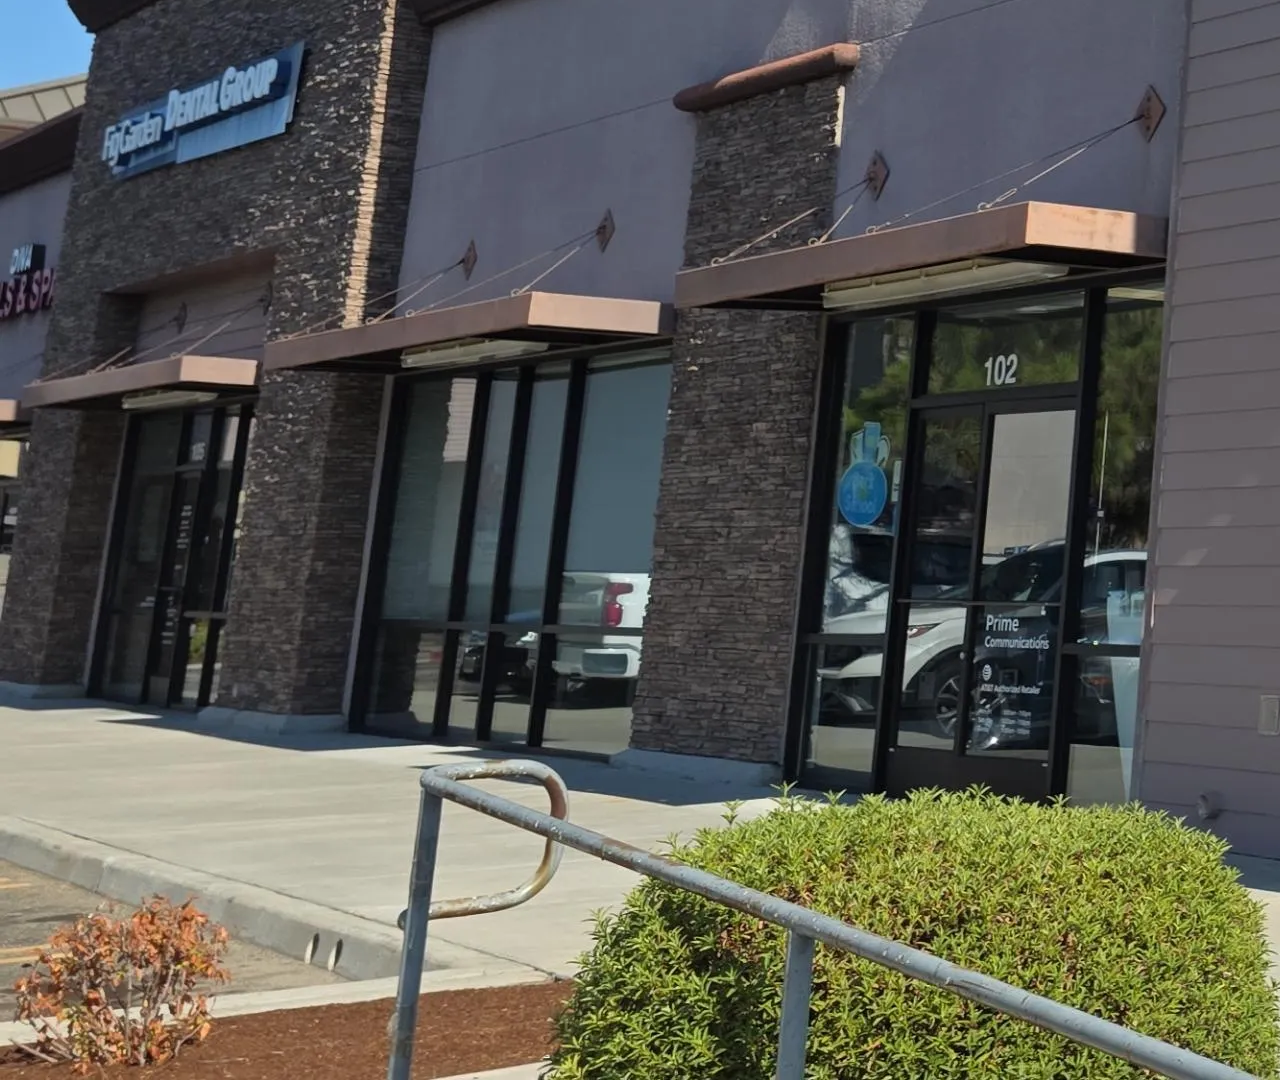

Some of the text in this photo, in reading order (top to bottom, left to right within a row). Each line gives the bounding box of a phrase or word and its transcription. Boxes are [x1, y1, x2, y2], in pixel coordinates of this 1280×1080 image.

[102, 124, 121, 167] Fig
[119, 112, 163, 155] Garden
[984, 353, 1019, 387] 102
[985, 614, 1020, 632] Prime
[984, 635, 1050, 650] Communications
